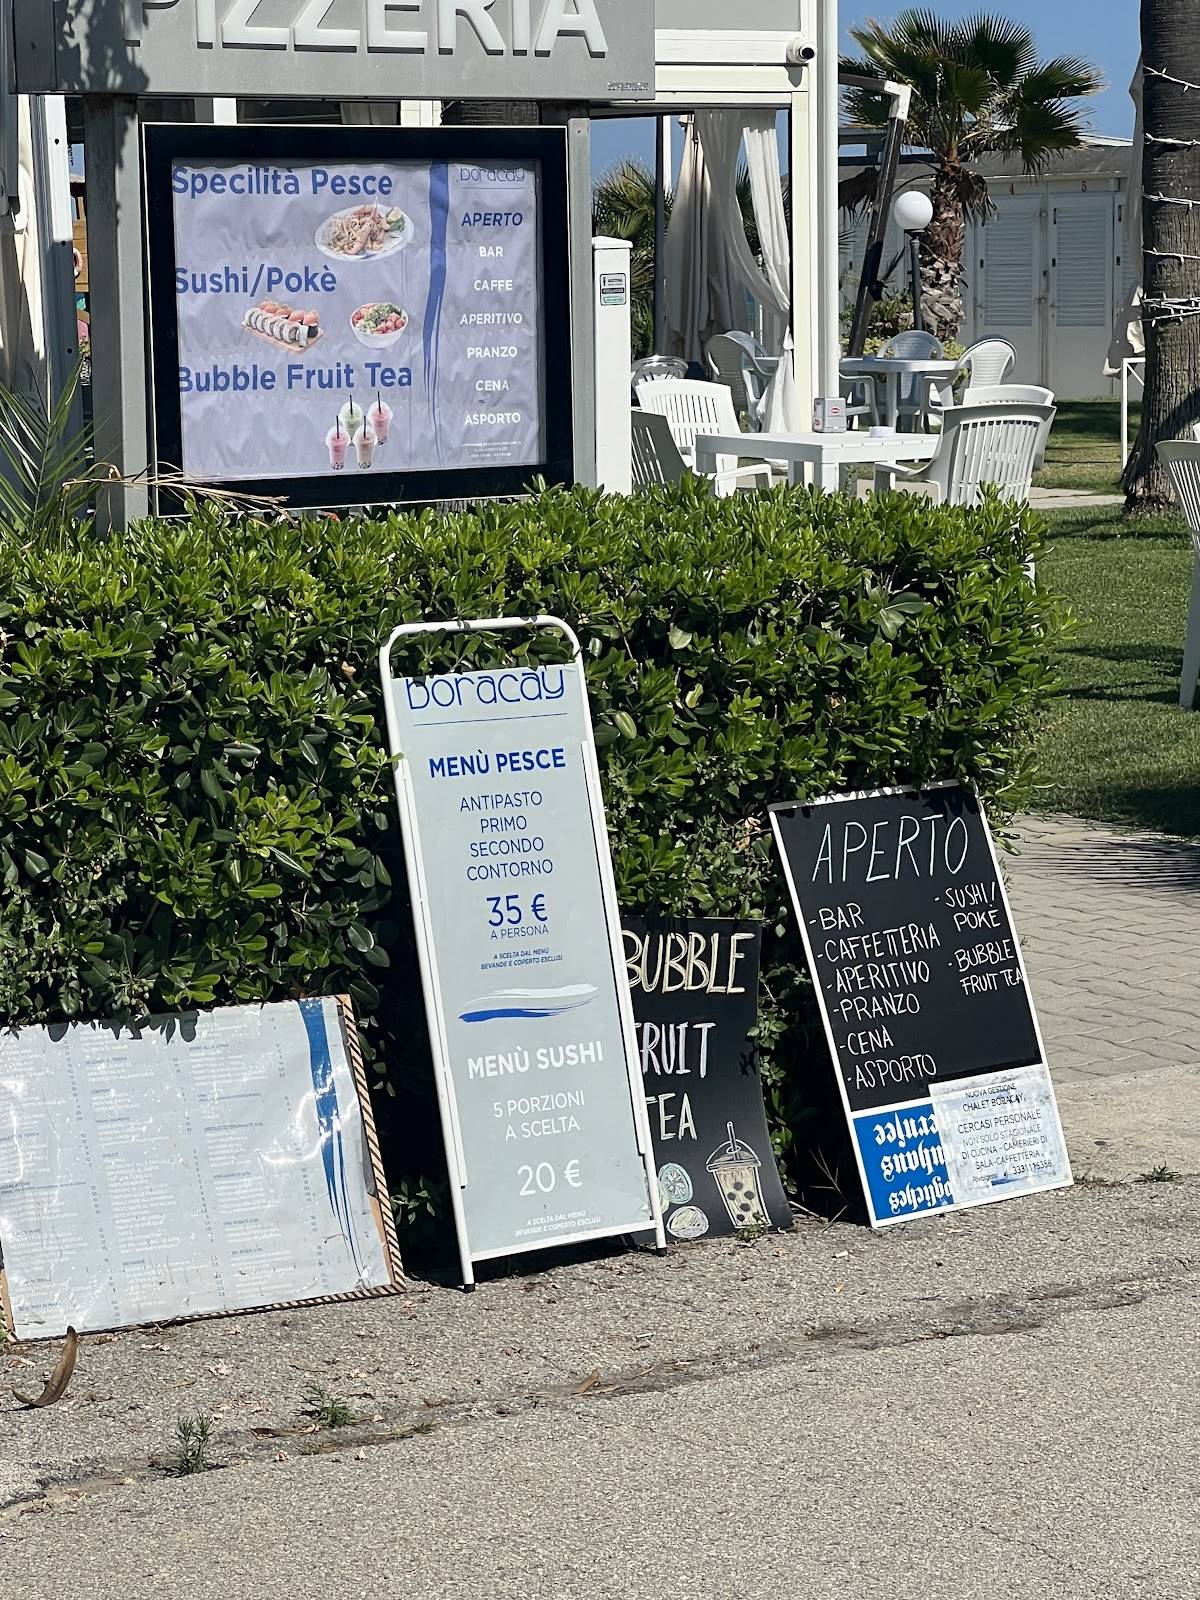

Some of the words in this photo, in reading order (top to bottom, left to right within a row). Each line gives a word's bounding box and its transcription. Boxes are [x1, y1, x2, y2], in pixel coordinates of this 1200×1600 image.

[312, 168, 393, 196] Pesce
[461, 212, 523, 227] APERTO
[479, 246, 504, 258] BAR
[175, 263, 337, 297] Sushi/Pokè
[474, 279, 513, 291] CAFFE
[460, 312, 523, 326] APERITIVO
[467, 346, 518, 359] PRANZO
[178, 364, 276, 392] Bubble
[287, 362, 354, 389] Fruit
[364, 362, 412, 388] Tea
[476, 379, 509, 392] CENA
[464, 413, 521, 426] ASPORTO
[429, 749, 490, 778] MENÙ
[496, 748, 566, 773] PESCE
[460, 791, 542, 812] ANTIPASTO
[480, 815, 527, 833] PRIMO
[470, 836, 544, 857] SECONDO
[812, 814, 969, 884] APERTO
[467, 859, 553, 881] CONTORNO
[486, 894, 522, 927] 35
[531, 893, 548, 922] €
[953, 909, 1002, 932] POKE
[490, 930, 498, 940] A
[501, 924, 550, 940] PERSONA
[480, 961, 508, 970] BEVANDE
[514, 957, 540, 966] COPERTO
[541, 954, 563, 963] ESCLUSI
[499, 951, 520, 959] SCELTA
[622, 929, 755, 994] BUBBLE
[960, 972, 999, 996] FRUIT
[1000, 966, 1024, 987] TEA
[468, 1046, 530, 1080] MENÙ
[536, 1040, 604, 1070] SUSHI
[635, 1021, 717, 1079] RUIT
[965, 1088, 988, 1099] NUOVA
[988, 1082, 1017, 1095] GESTIONE
[493, 1101, 503, 1118] 5
[508, 1089, 585, 1116] PORZIONI
[962, 1099, 989, 1112] CHALET
[505, 1124, 517, 1141] A
[521, 1115, 580, 1139] SCELTA
[957, 1119, 994, 1135] CERCASI
[994, 1108, 1042, 1129] PERSONALE
[962, 1137, 979, 1147] NON
[980, 1132, 999, 1144] SOLO
[1000, 1123, 1042, 1140] STAGIONALE
[961, 1151, 970, 1159] DI
[970, 1145, 998, 1158] CUCINA
[1003, 1137, 1040, 1151] CAMERIERI
[1040, 1135, 1048, 1144] DI
[517, 1162, 556, 1196] 20
[564, 1159, 583, 1188] €
[533, 1215, 553, 1225] SCELTA
[555, 1213, 567, 1221] DAL
